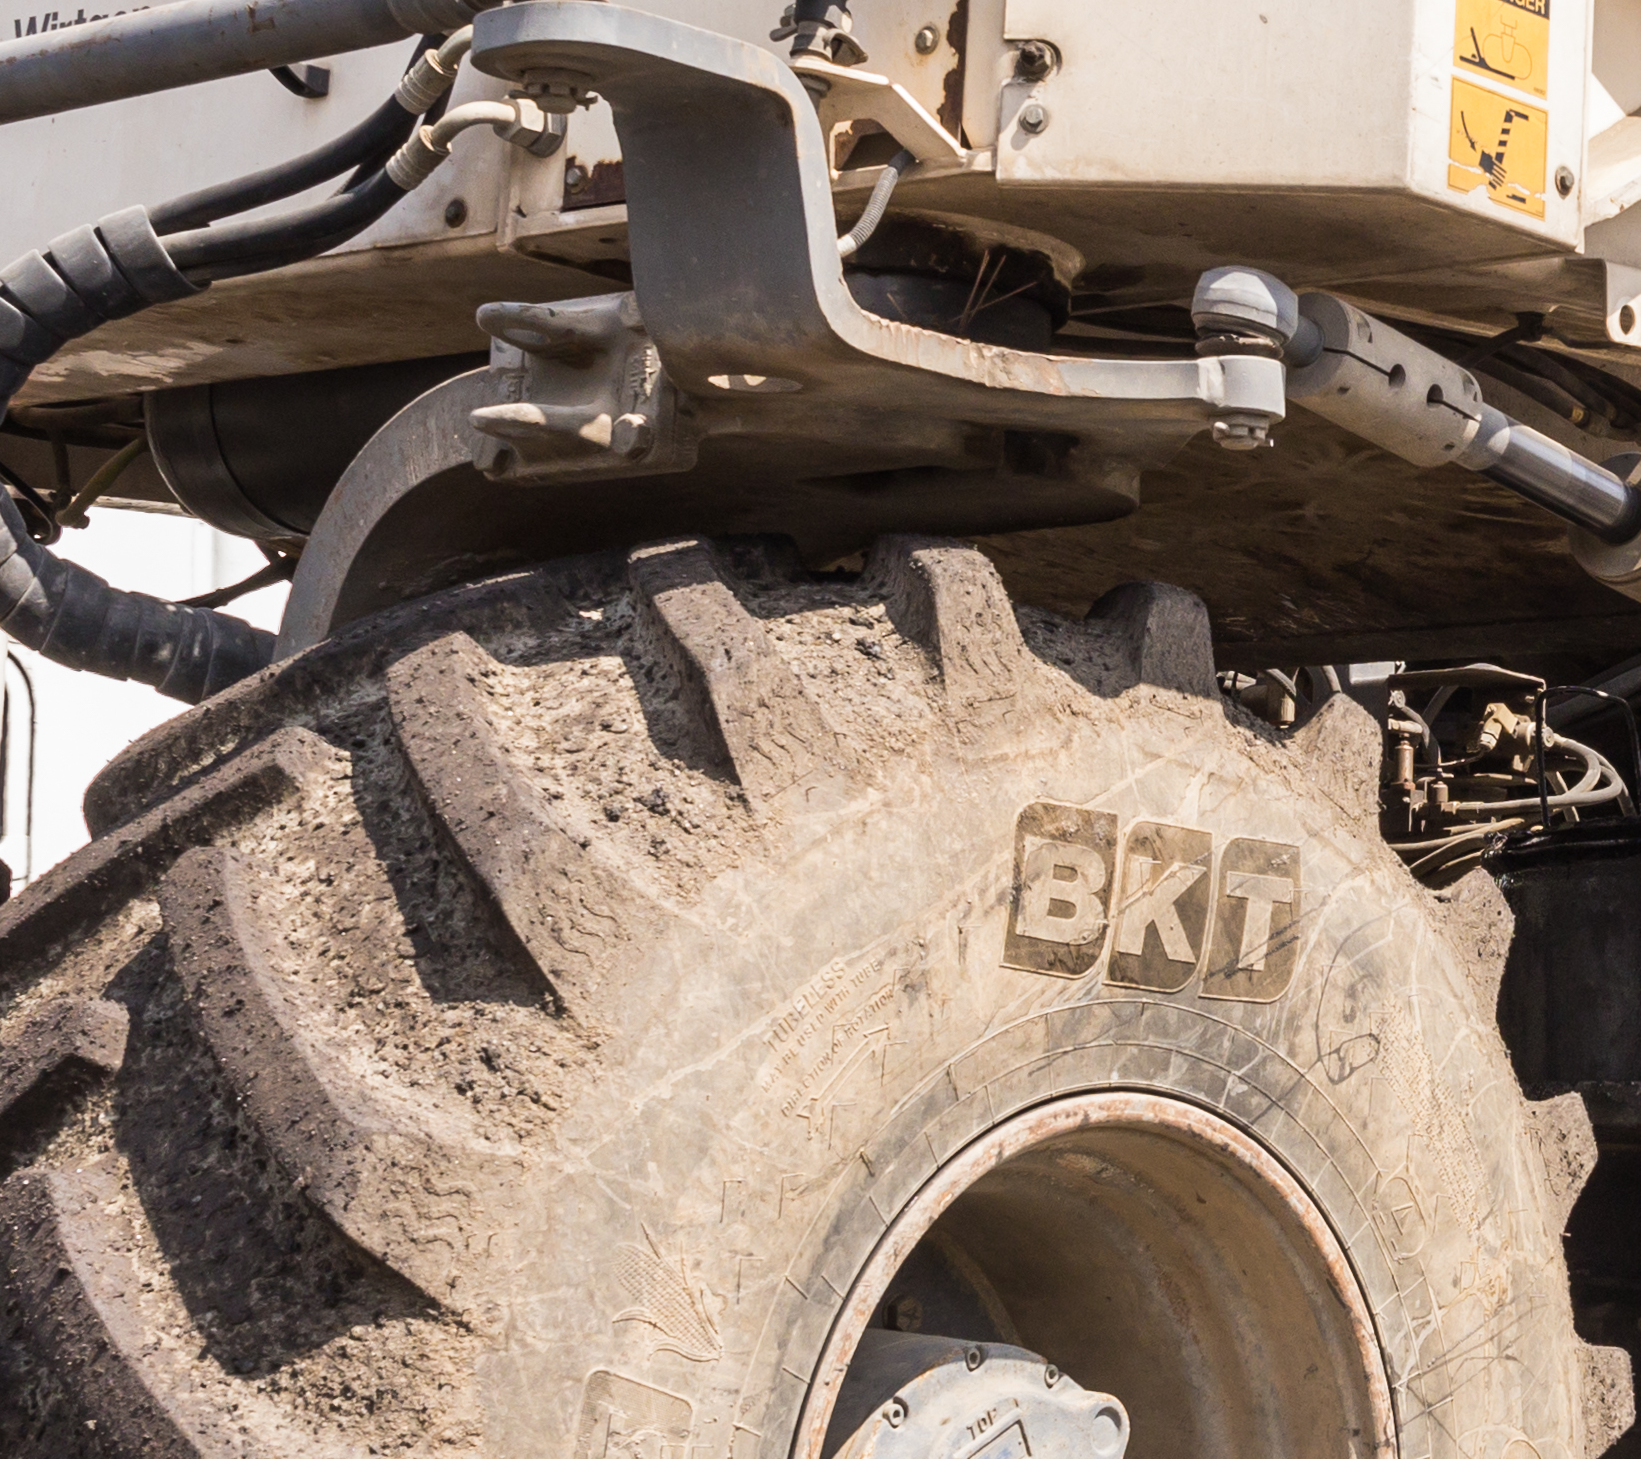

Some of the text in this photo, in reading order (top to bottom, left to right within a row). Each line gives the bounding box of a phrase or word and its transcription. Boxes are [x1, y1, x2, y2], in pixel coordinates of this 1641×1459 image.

[1014, 834, 1295, 973] BKT
[762, 960, 847, 1053] TUBELESS
[966, 1407, 997, 1440] TOP
